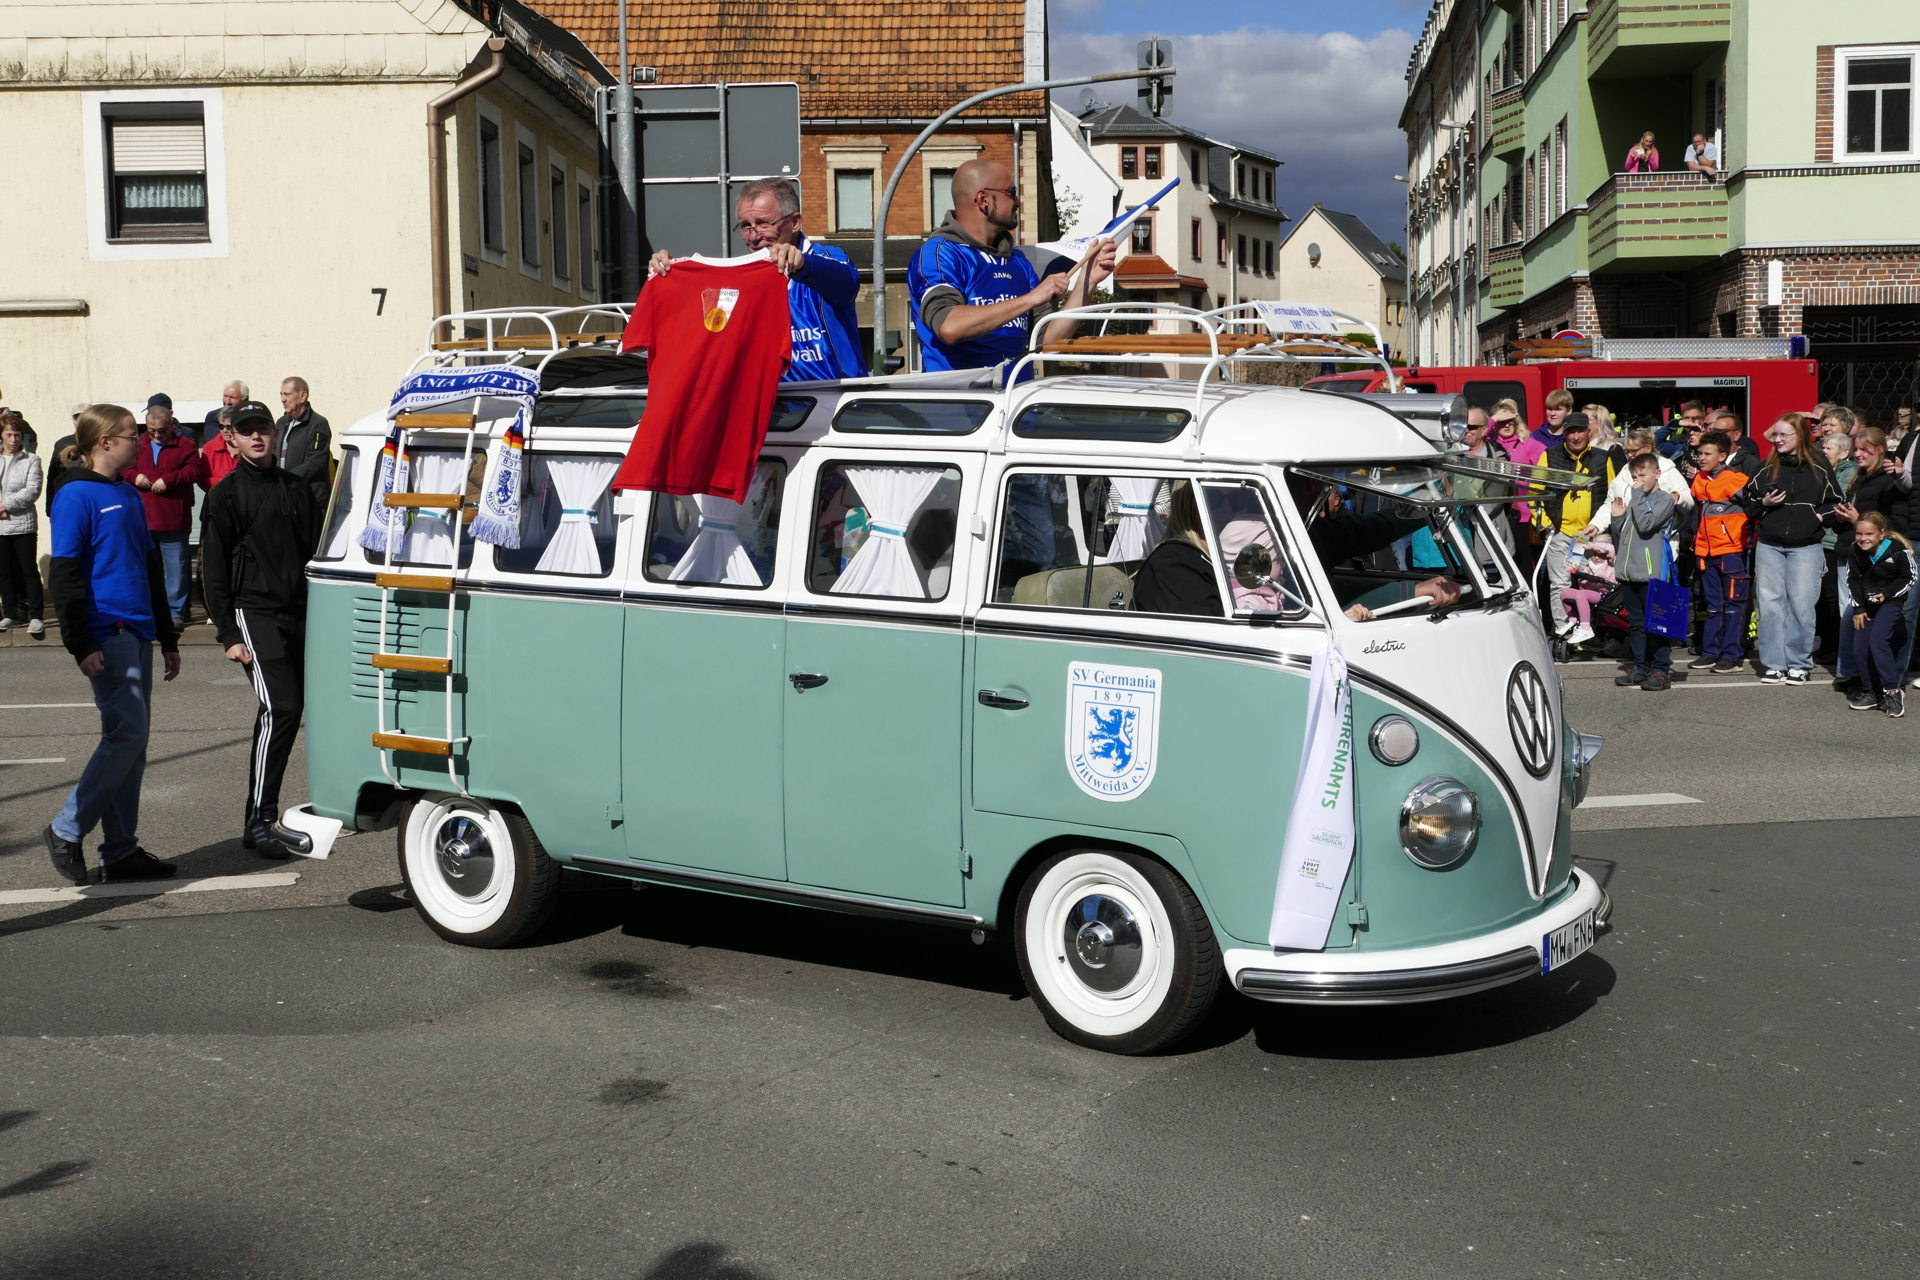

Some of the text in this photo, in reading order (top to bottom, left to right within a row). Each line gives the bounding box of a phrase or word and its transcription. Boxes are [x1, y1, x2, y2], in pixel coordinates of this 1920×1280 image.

[371, 288, 387, 316] 7
[1299, 306, 1333, 317] Mittwida
[791, 344, 823, 362] wahl
[393, 376, 456, 399] RMANIA
[410, 393, 450, 403] FUSSBALL
[1362, 639, 1406, 654] electric
[1072, 667, 1156, 689] SV Germania
[1094, 690, 1133, 704] 1897
[1321, 703, 1352, 810] EHRENAMTS
[1074, 753, 1129, 792] Mittweida
[1302, 865, 1318, 873] bund
[1303, 861, 1320, 869] sport
[1550, 929, 1567, 966] MW
